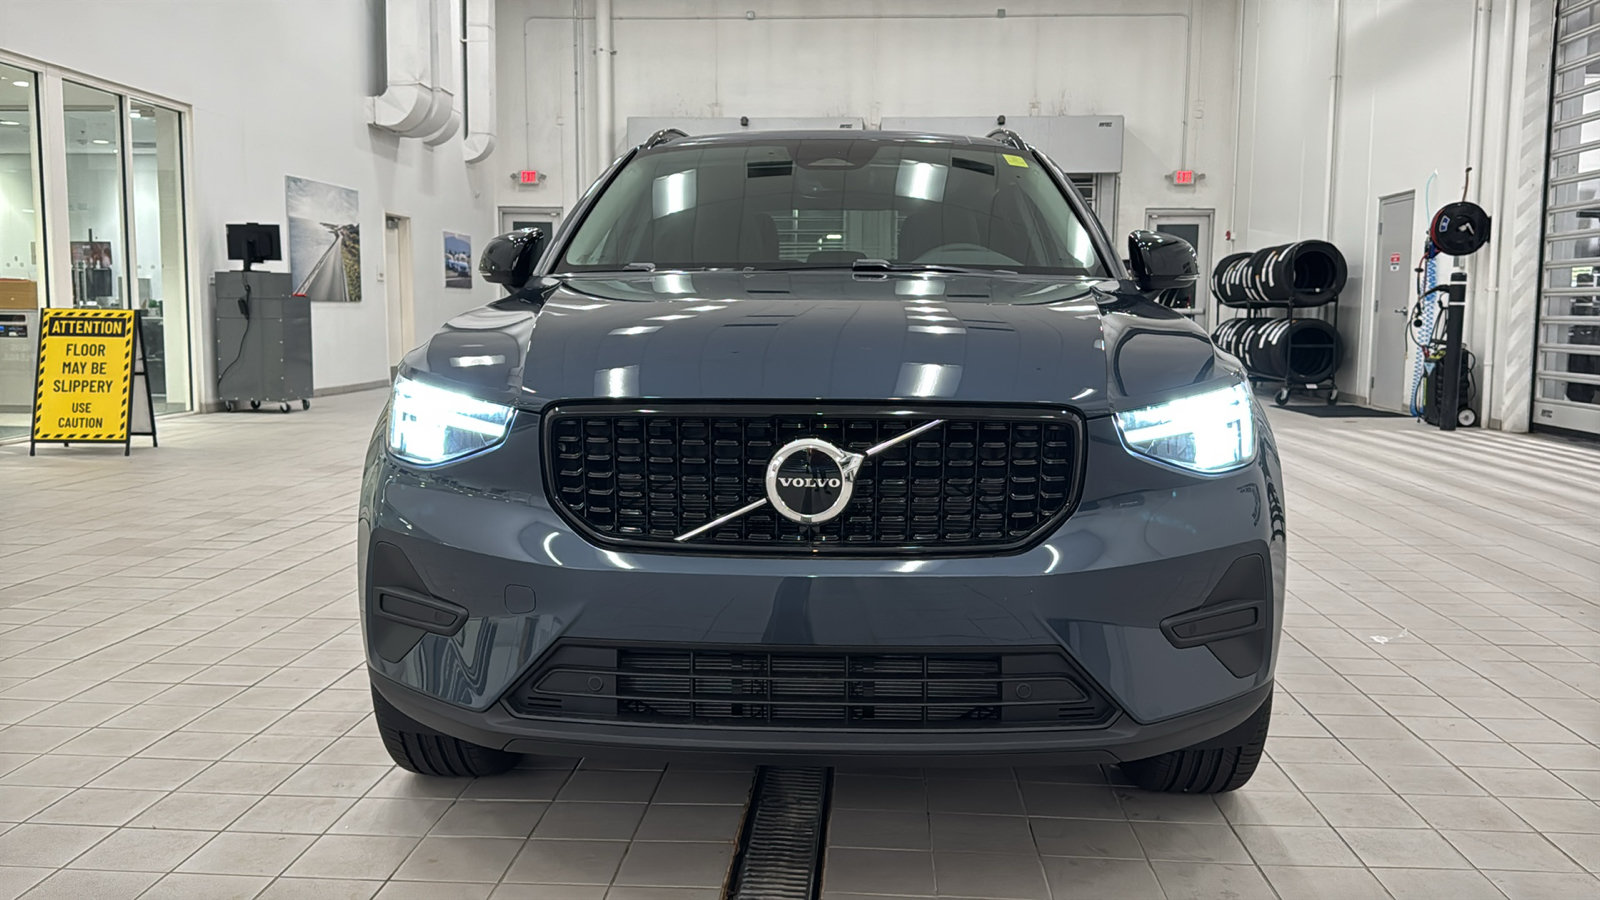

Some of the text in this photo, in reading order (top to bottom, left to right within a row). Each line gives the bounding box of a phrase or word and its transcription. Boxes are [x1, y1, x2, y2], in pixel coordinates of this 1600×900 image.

[51, 320, 123, 334] ATTENTION
[65, 343, 106, 357] FLOOR
[62, 361, 107, 375] MAY BE
[53, 379, 113, 393] SLIPPERY
[71, 402, 92, 413] USE
[58, 417, 103, 428] CAUTION
[778, 477, 841, 488] VOLVO
